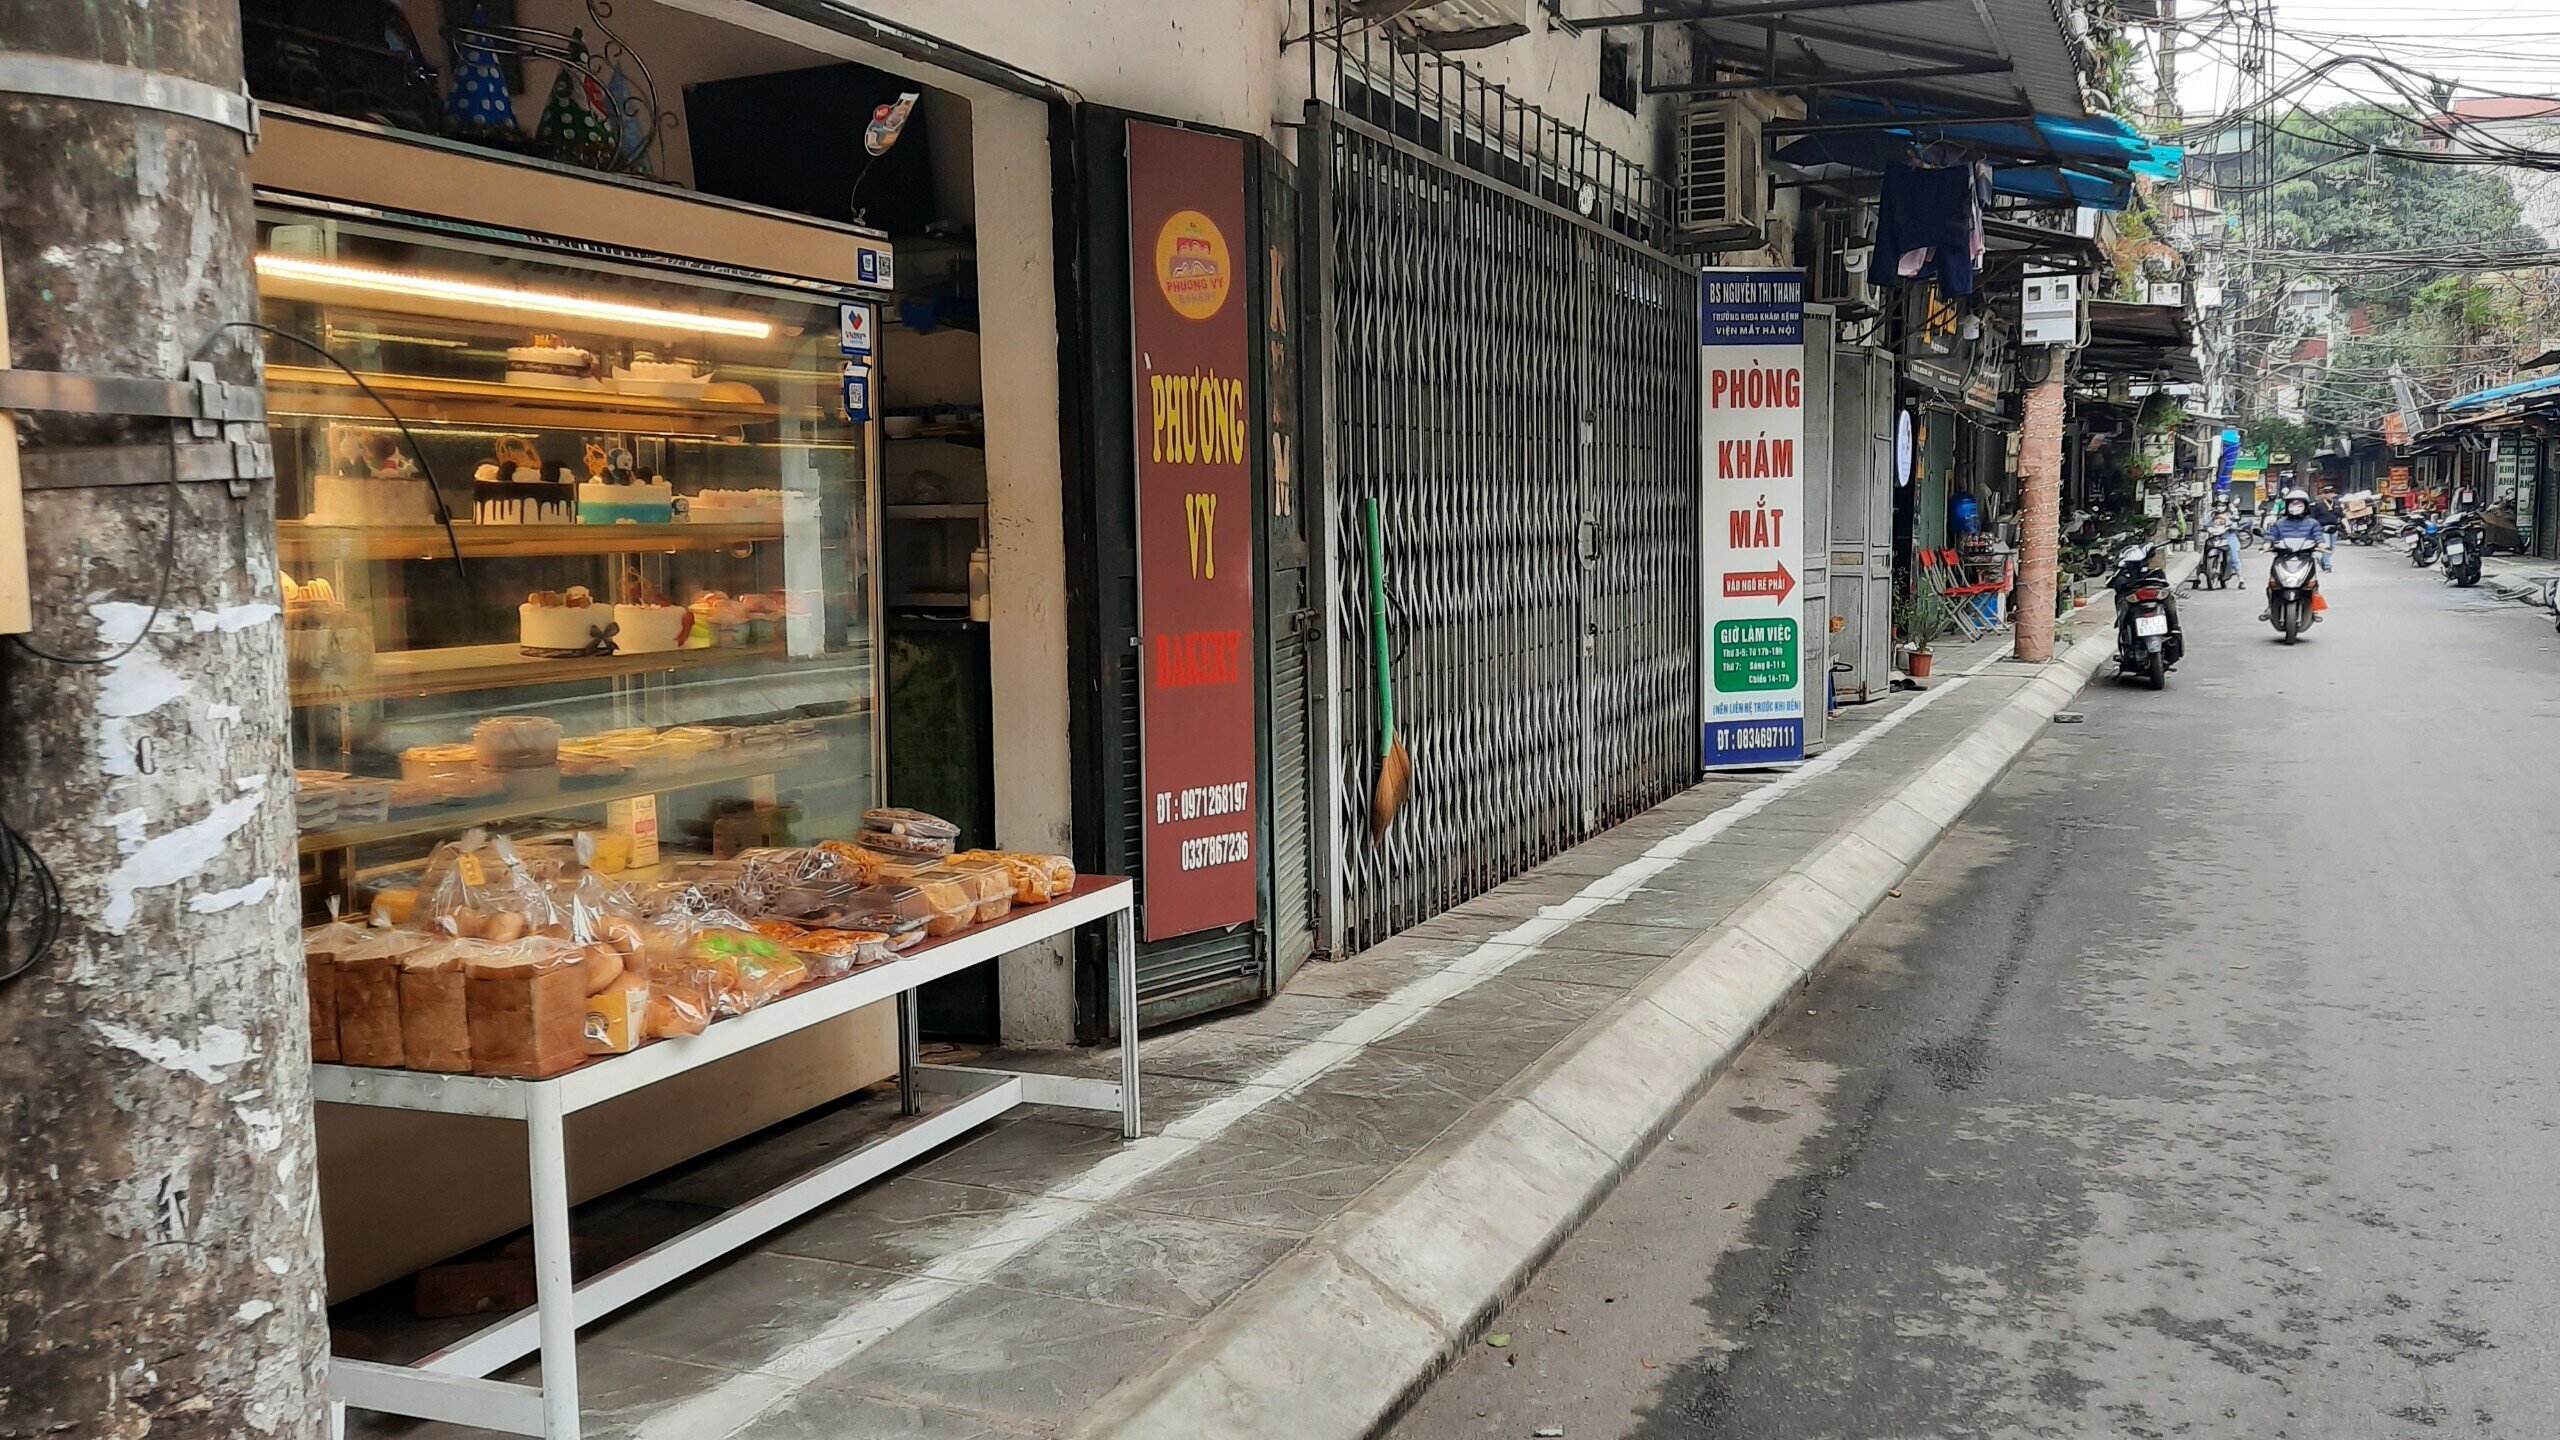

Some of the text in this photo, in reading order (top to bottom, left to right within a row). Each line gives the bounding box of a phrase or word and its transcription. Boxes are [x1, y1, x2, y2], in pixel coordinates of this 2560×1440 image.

[1710, 283, 1721, 303] BS
[1758, 283, 1772, 307] THỊ
[1773, 282, 1800, 303] THANH
[1716, 324, 1795, 336] VIỆN MẮT HÀ NỘI
[1741, 313, 1758, 321] KHOA
[1760, 311, 1780, 321] KHÁM
[1712, 359, 1800, 408] PHÒNG
[1151, 365, 1244, 465] PHƯƠNG
[1719, 431, 1793, 478] KHÁM
[1186, 493, 1217, 580] VY
[1730, 494, 1783, 548] MẮT
[1721, 624, 1791, 644] GIỜ LÀM VIỆC
[1156, 630, 1241, 689] BAKERY
[1730, 701, 1743, 714] LIÊN
[1745, 700, 1752, 715] HỆ
[1775, 700, 1785, 712] KHI
[1737, 726, 1795, 749] 0834697111
[1181, 782, 1247, 819] 0971268197
[1182, 831, 1248, 871] 0337867236
